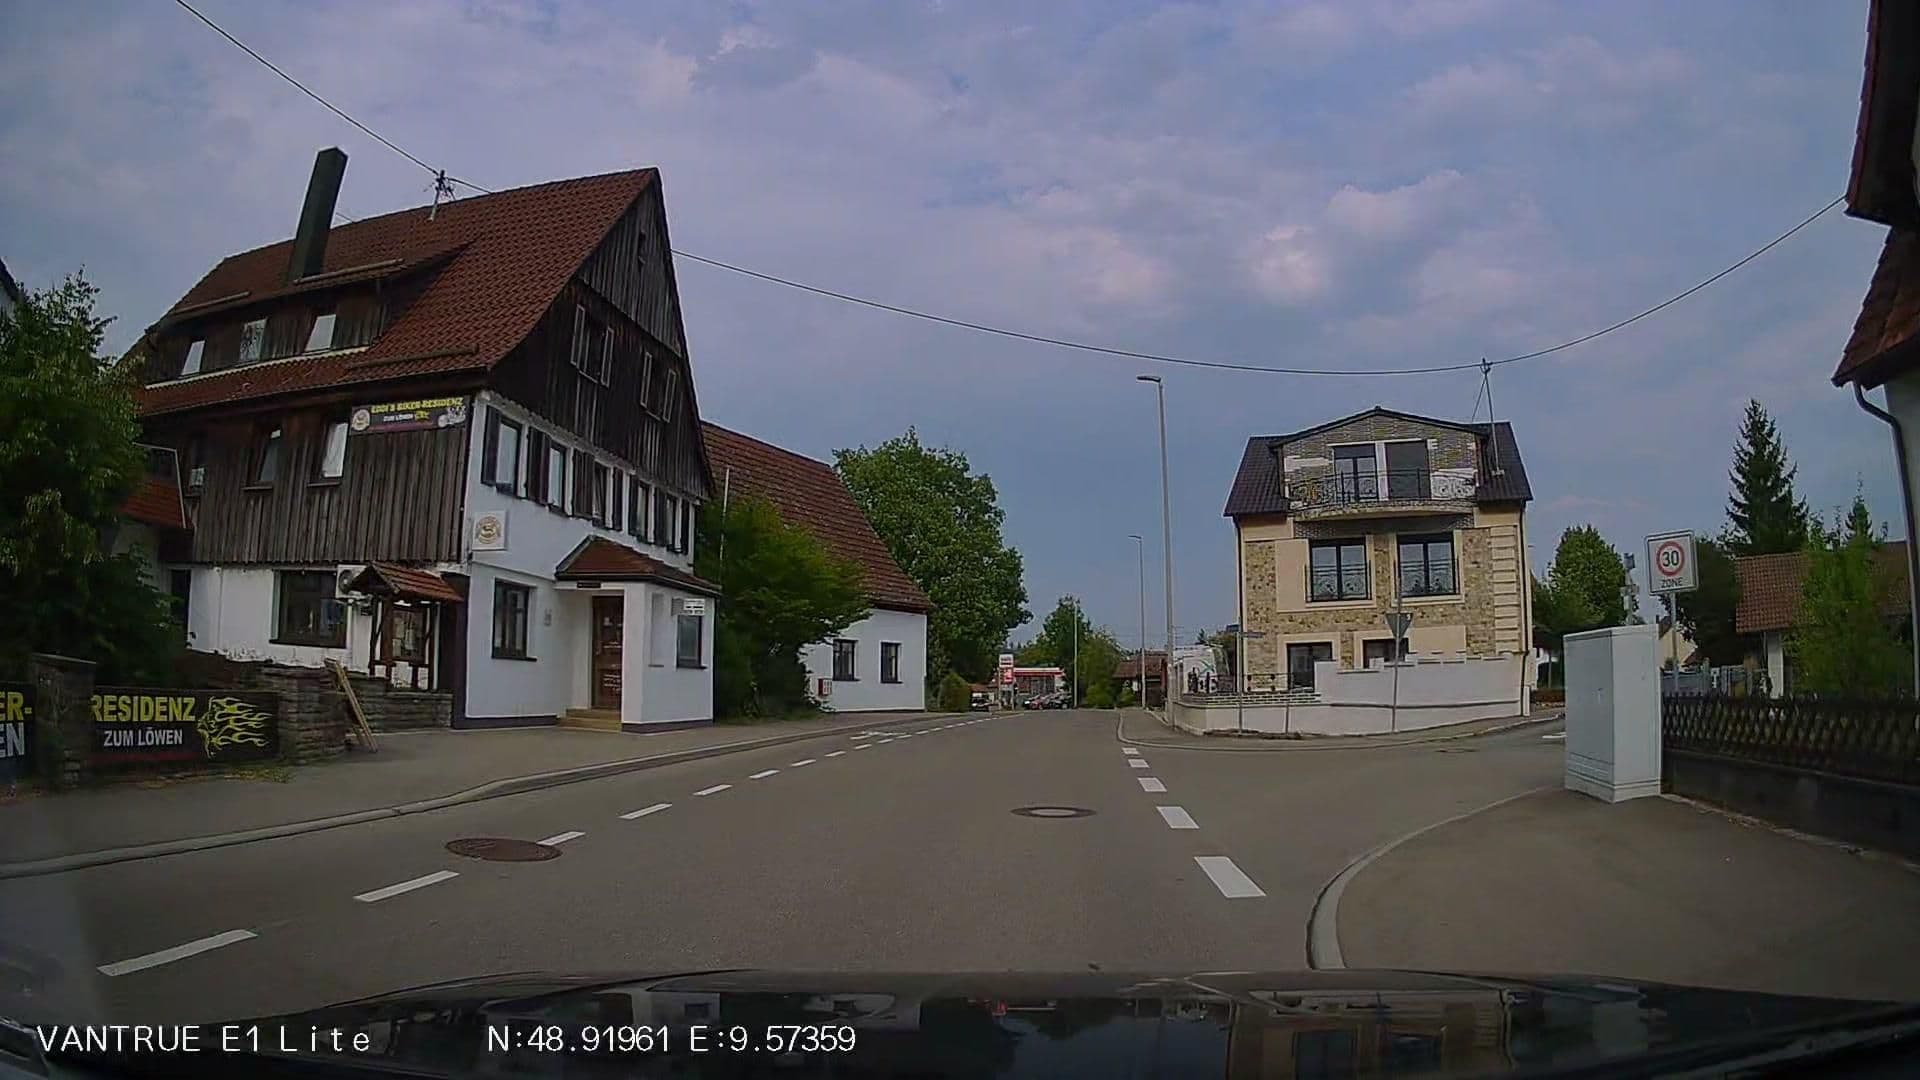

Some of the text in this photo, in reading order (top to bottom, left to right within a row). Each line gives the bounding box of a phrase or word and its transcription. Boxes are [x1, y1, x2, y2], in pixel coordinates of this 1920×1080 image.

[1662, 550, 1680, 567] 30
[1661, 577, 1683, 588] ZONE
[90, 695, 196, 721] RESIDENZ
[103, 727, 183, 747] ZUM LÖWEN
